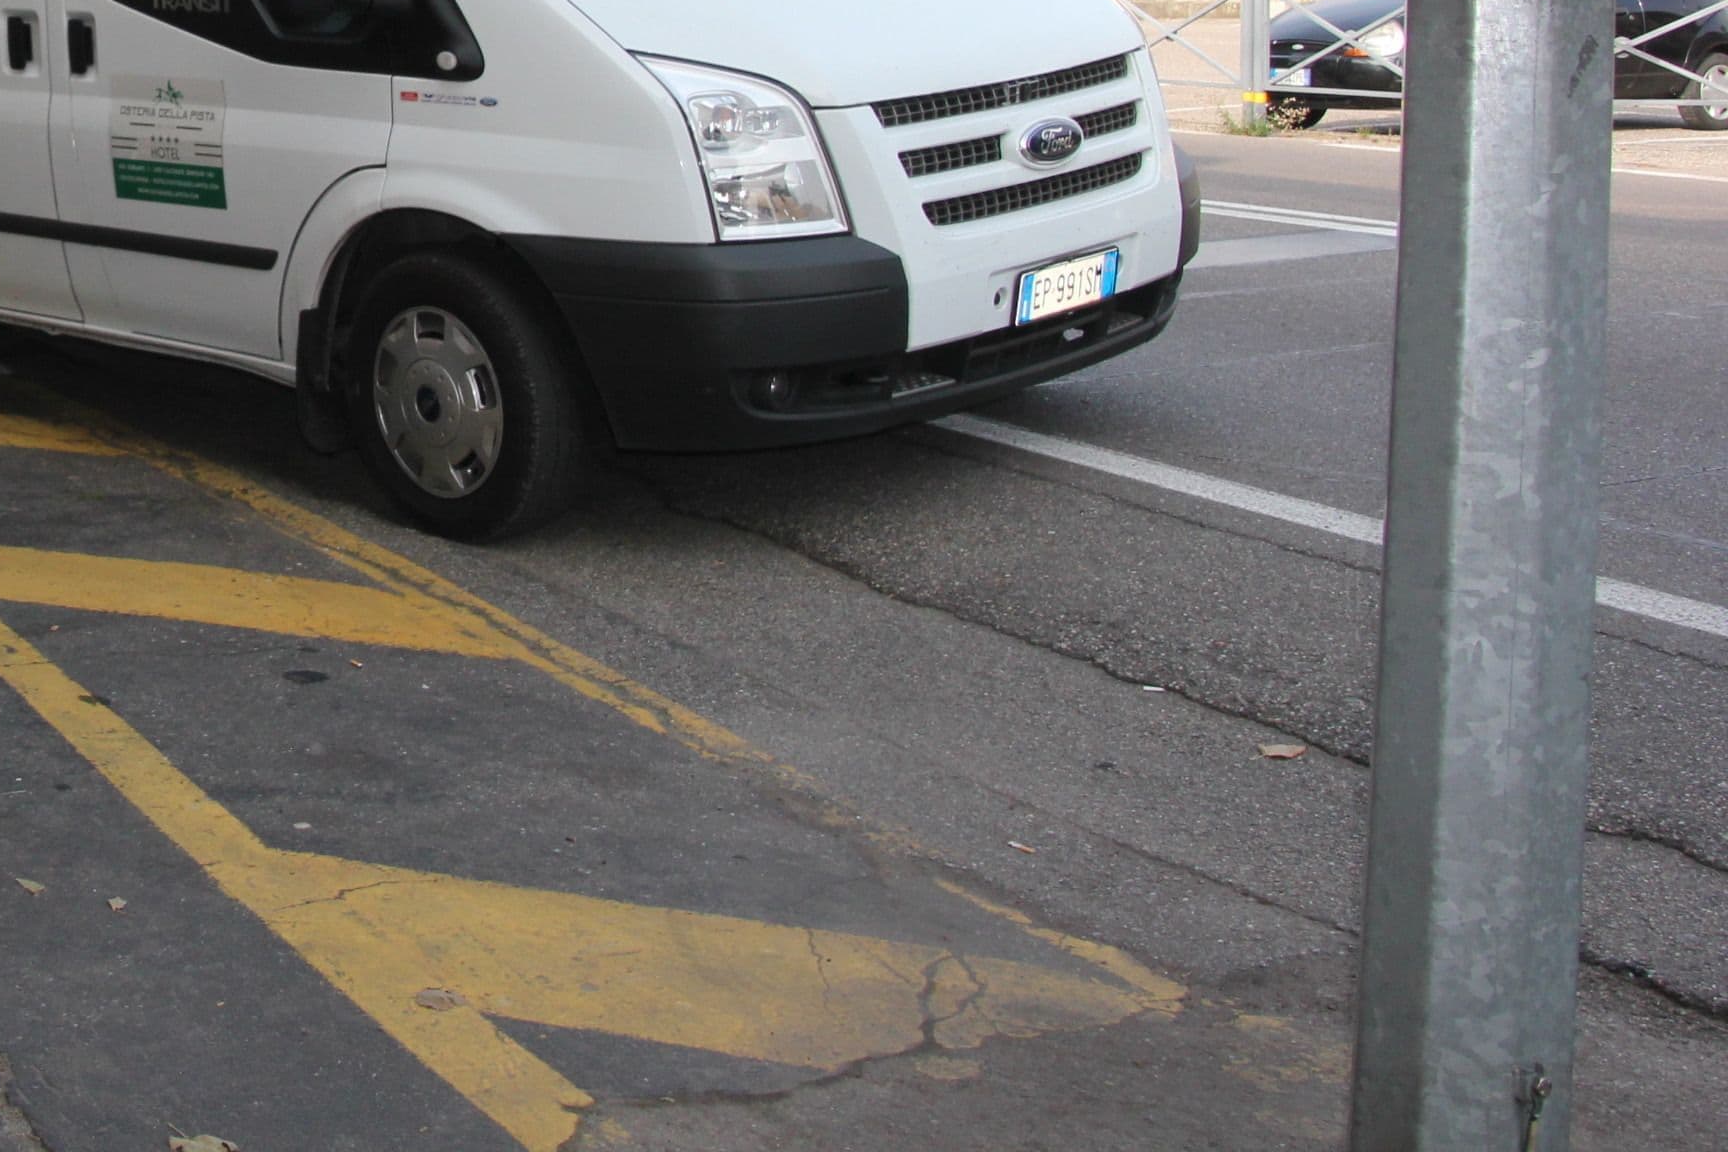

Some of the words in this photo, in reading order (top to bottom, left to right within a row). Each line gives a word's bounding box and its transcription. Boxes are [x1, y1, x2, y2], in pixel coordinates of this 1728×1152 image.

[119, 105, 156, 118] OSTERIA
[158, 108, 188, 121] DELLA
[189, 110, 216, 122] PISTA
[1040, 126, 1074, 154] Ford
[150, 146, 180, 161] HOTEL
